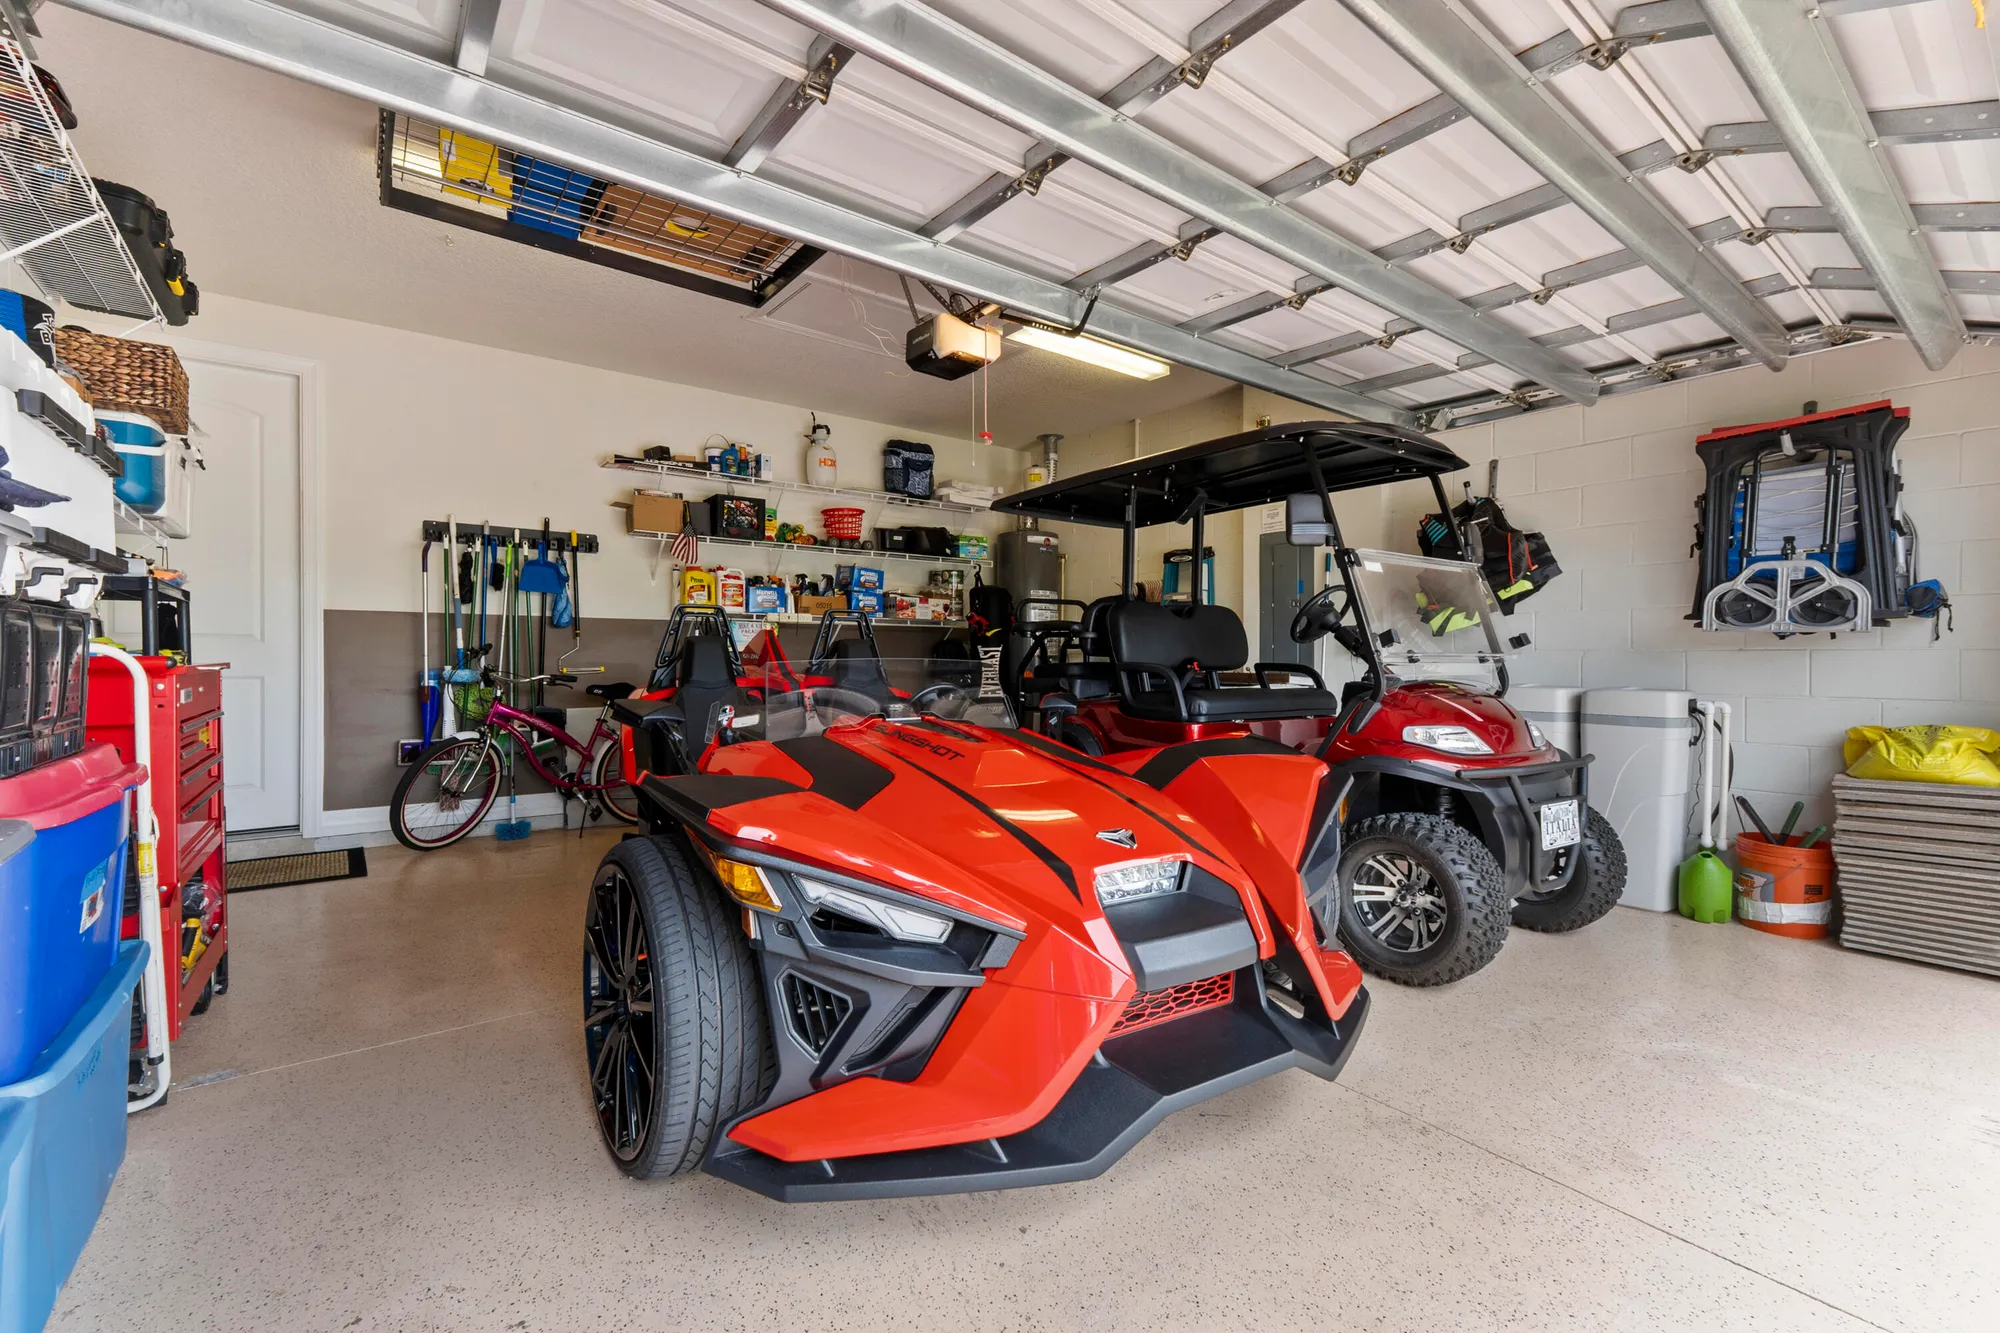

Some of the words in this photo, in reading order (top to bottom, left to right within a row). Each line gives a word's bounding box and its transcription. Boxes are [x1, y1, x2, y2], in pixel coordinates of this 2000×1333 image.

[977, 644, 1004, 698] EVERLAST
[872, 724, 966, 760] SLINGSHOT
[1545, 817, 1577, 835] ITALIA
